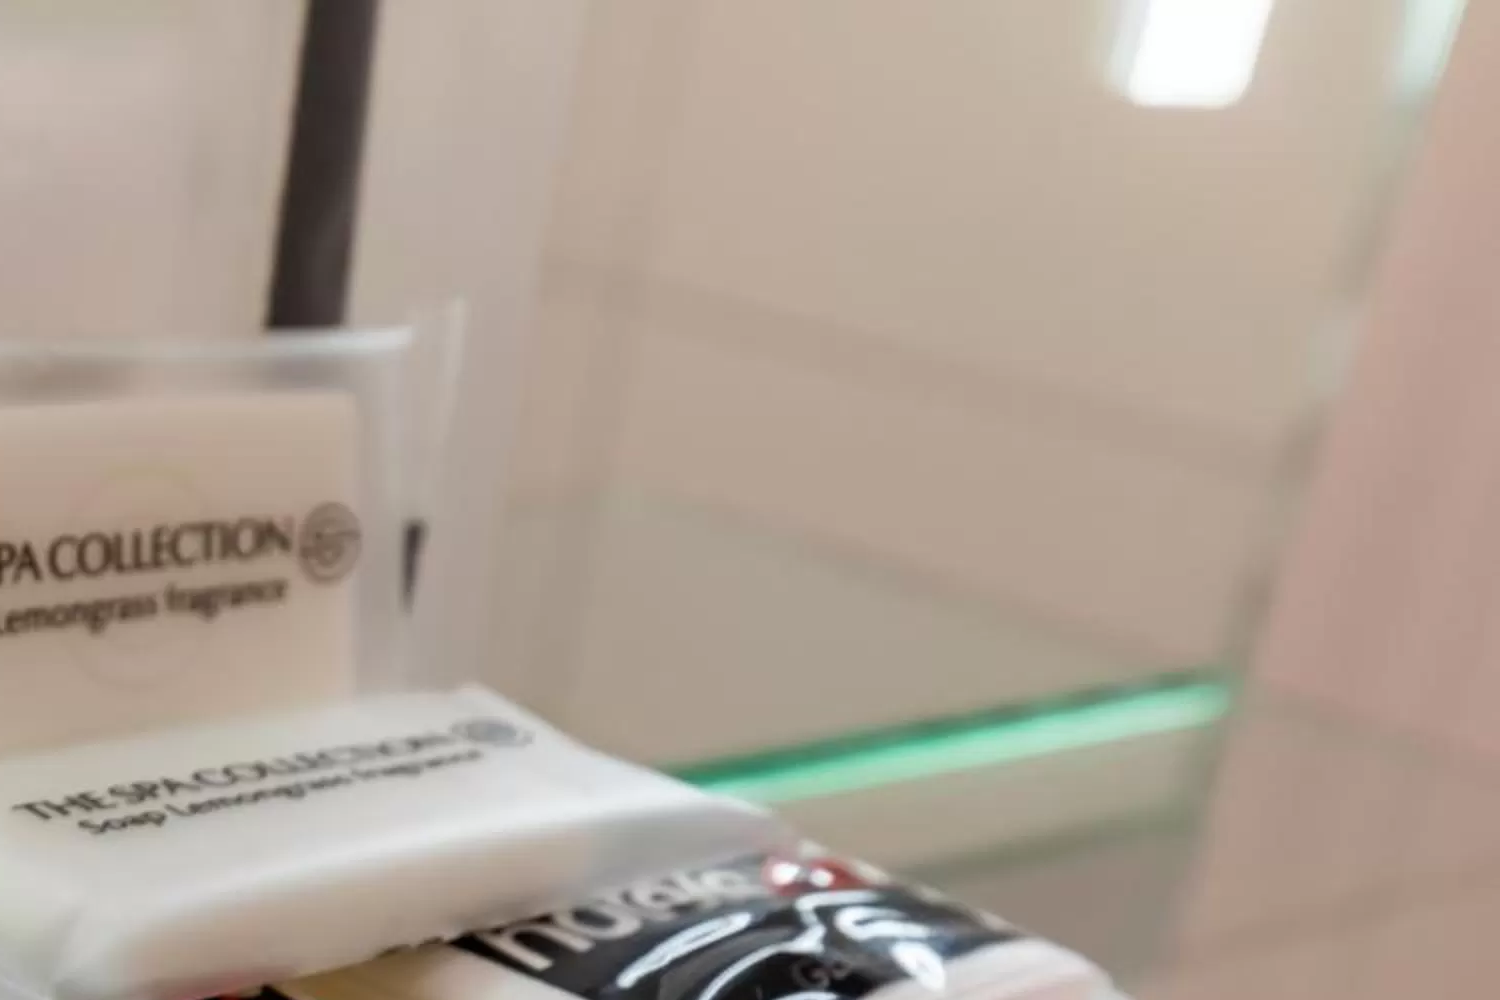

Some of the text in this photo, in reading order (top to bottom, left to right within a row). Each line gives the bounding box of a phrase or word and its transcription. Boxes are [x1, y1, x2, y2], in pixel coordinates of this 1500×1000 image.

[47, 517, 294, 582] COLLECTION
[11, 788, 117, 820] THE
[107, 777, 202, 805] SPA
[77, 810, 168, 835] Soap
